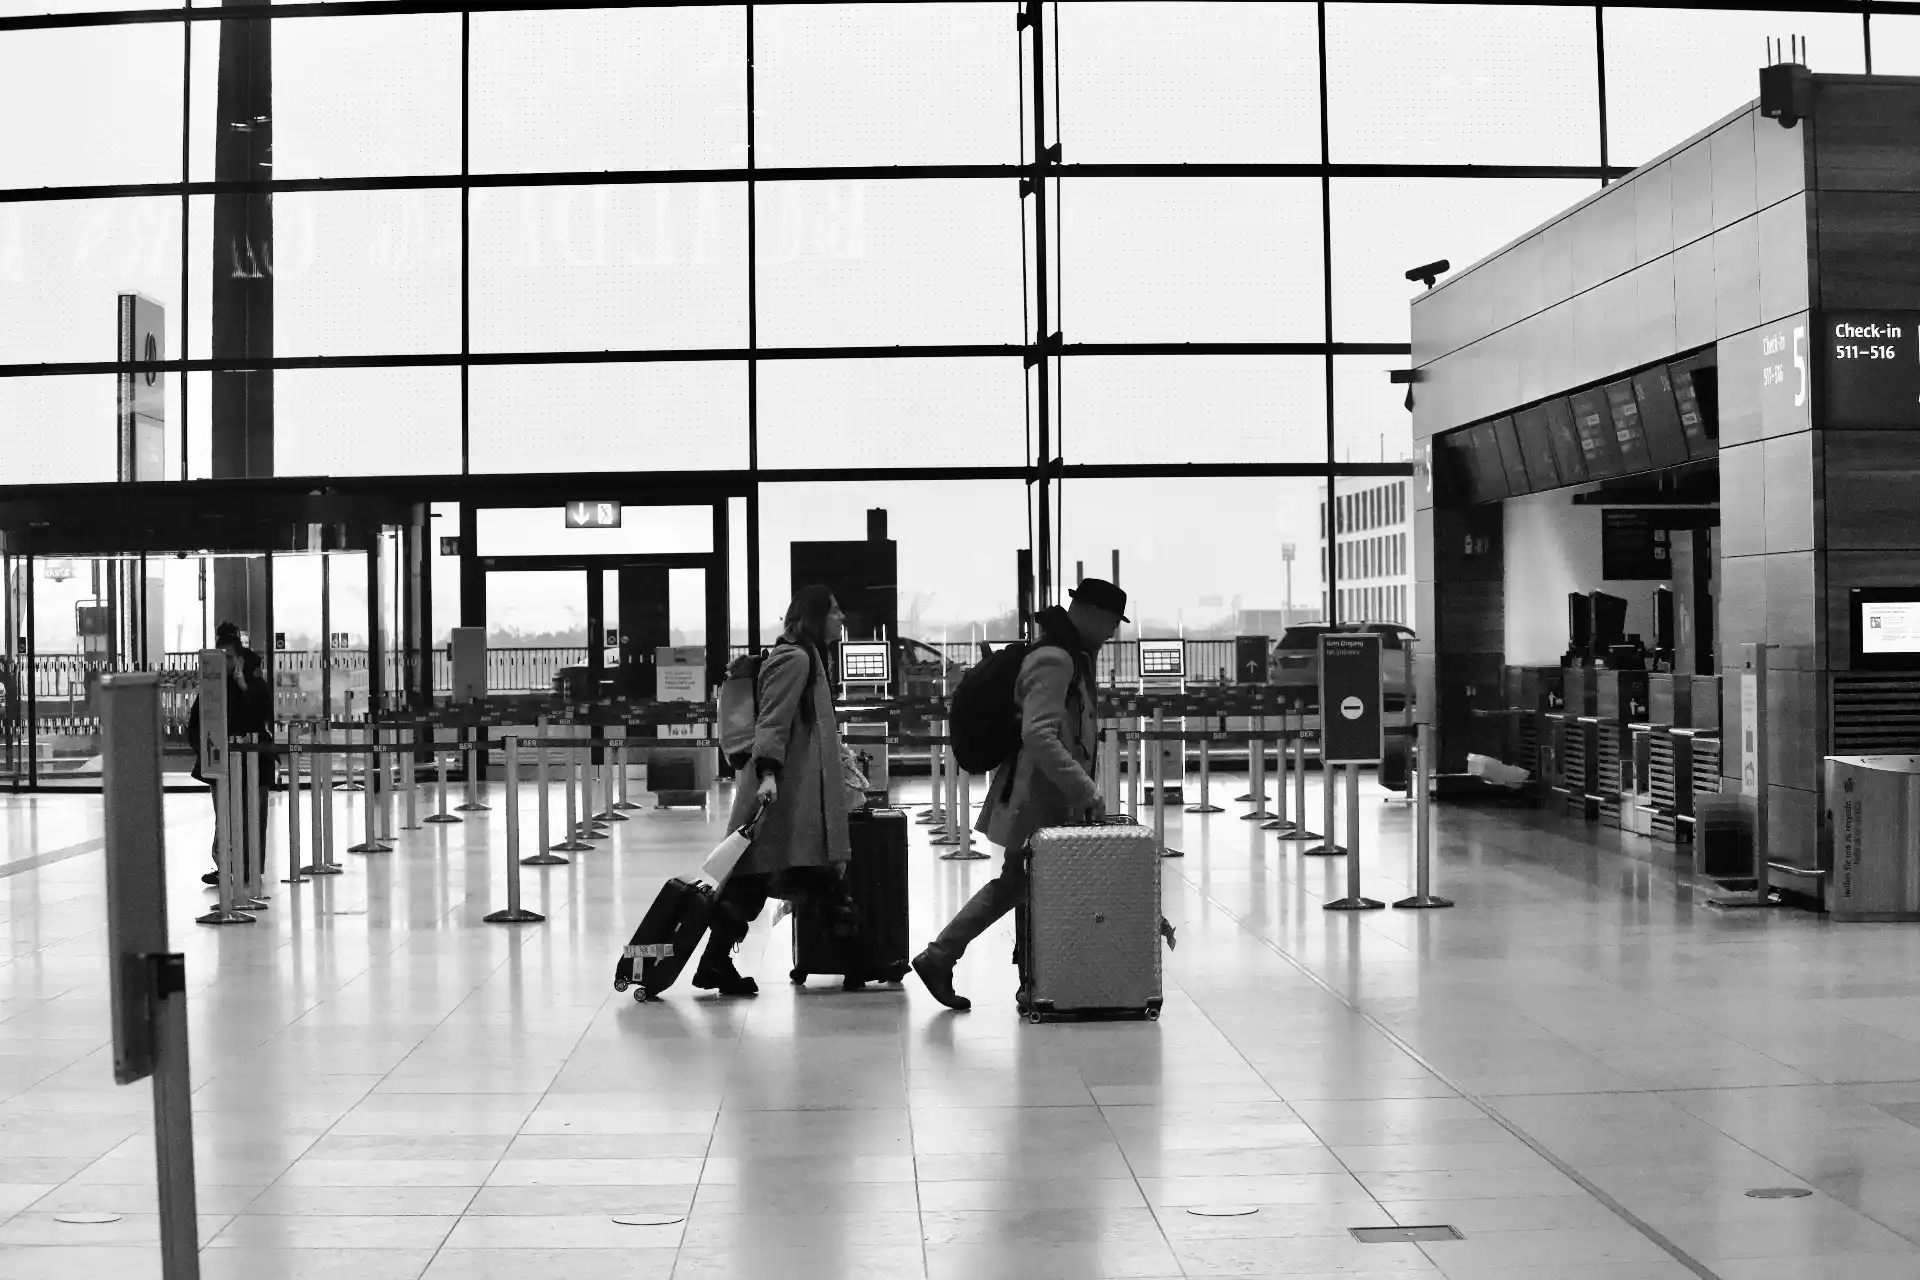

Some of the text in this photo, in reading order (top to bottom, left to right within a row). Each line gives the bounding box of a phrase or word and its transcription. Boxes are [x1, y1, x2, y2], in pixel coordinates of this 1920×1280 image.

[1835, 323, 1902, 338] Check-in
[1763, 332, 1786, 356] Check-in
[1836, 345, 1896, 359] 511–516
[1793, 326, 1806, 406] 5
[609, 739, 624, 747] BER
[696, 739, 711, 747] BER
[885, 736, 899, 744] BER
[459, 742, 473, 750] BER
